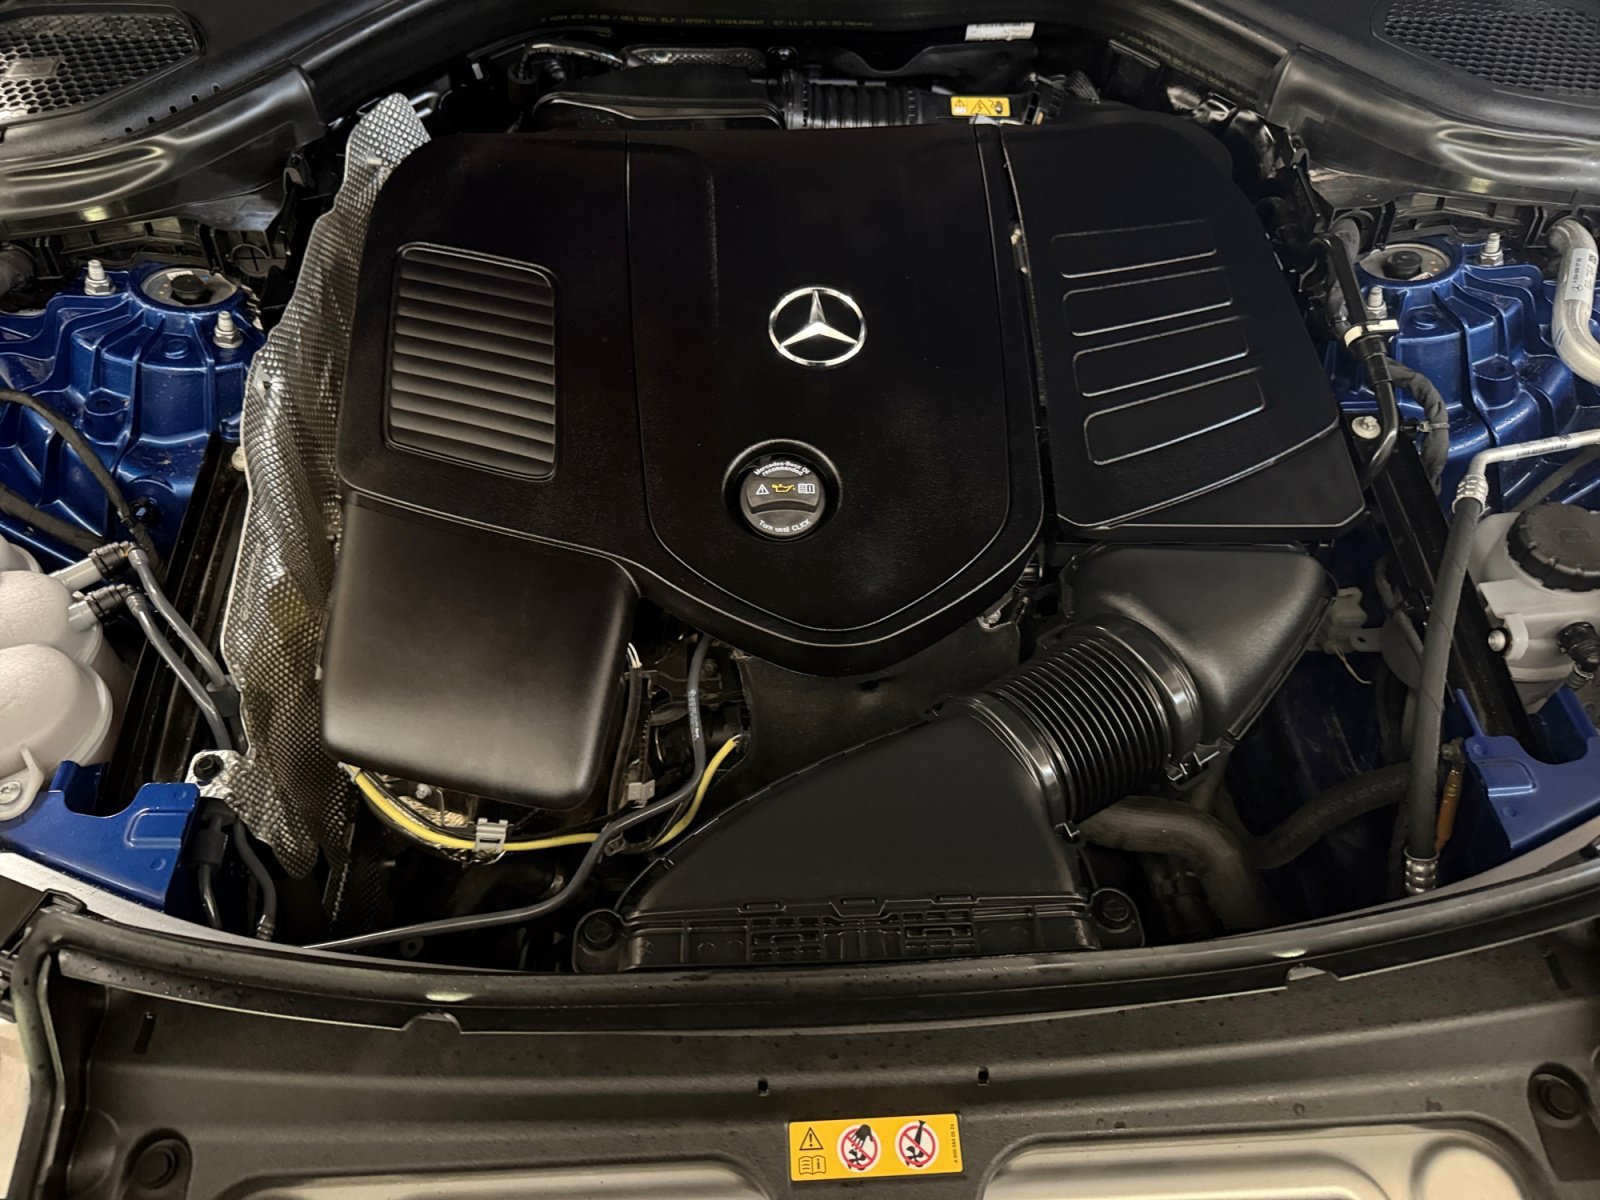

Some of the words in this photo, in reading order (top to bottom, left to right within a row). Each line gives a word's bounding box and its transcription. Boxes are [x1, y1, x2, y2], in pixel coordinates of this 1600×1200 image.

[754, 461, 802, 475] Mercedes-Benz
[759, 519, 773, 531] Turn
[792, 519, 811, 531] CLICK
